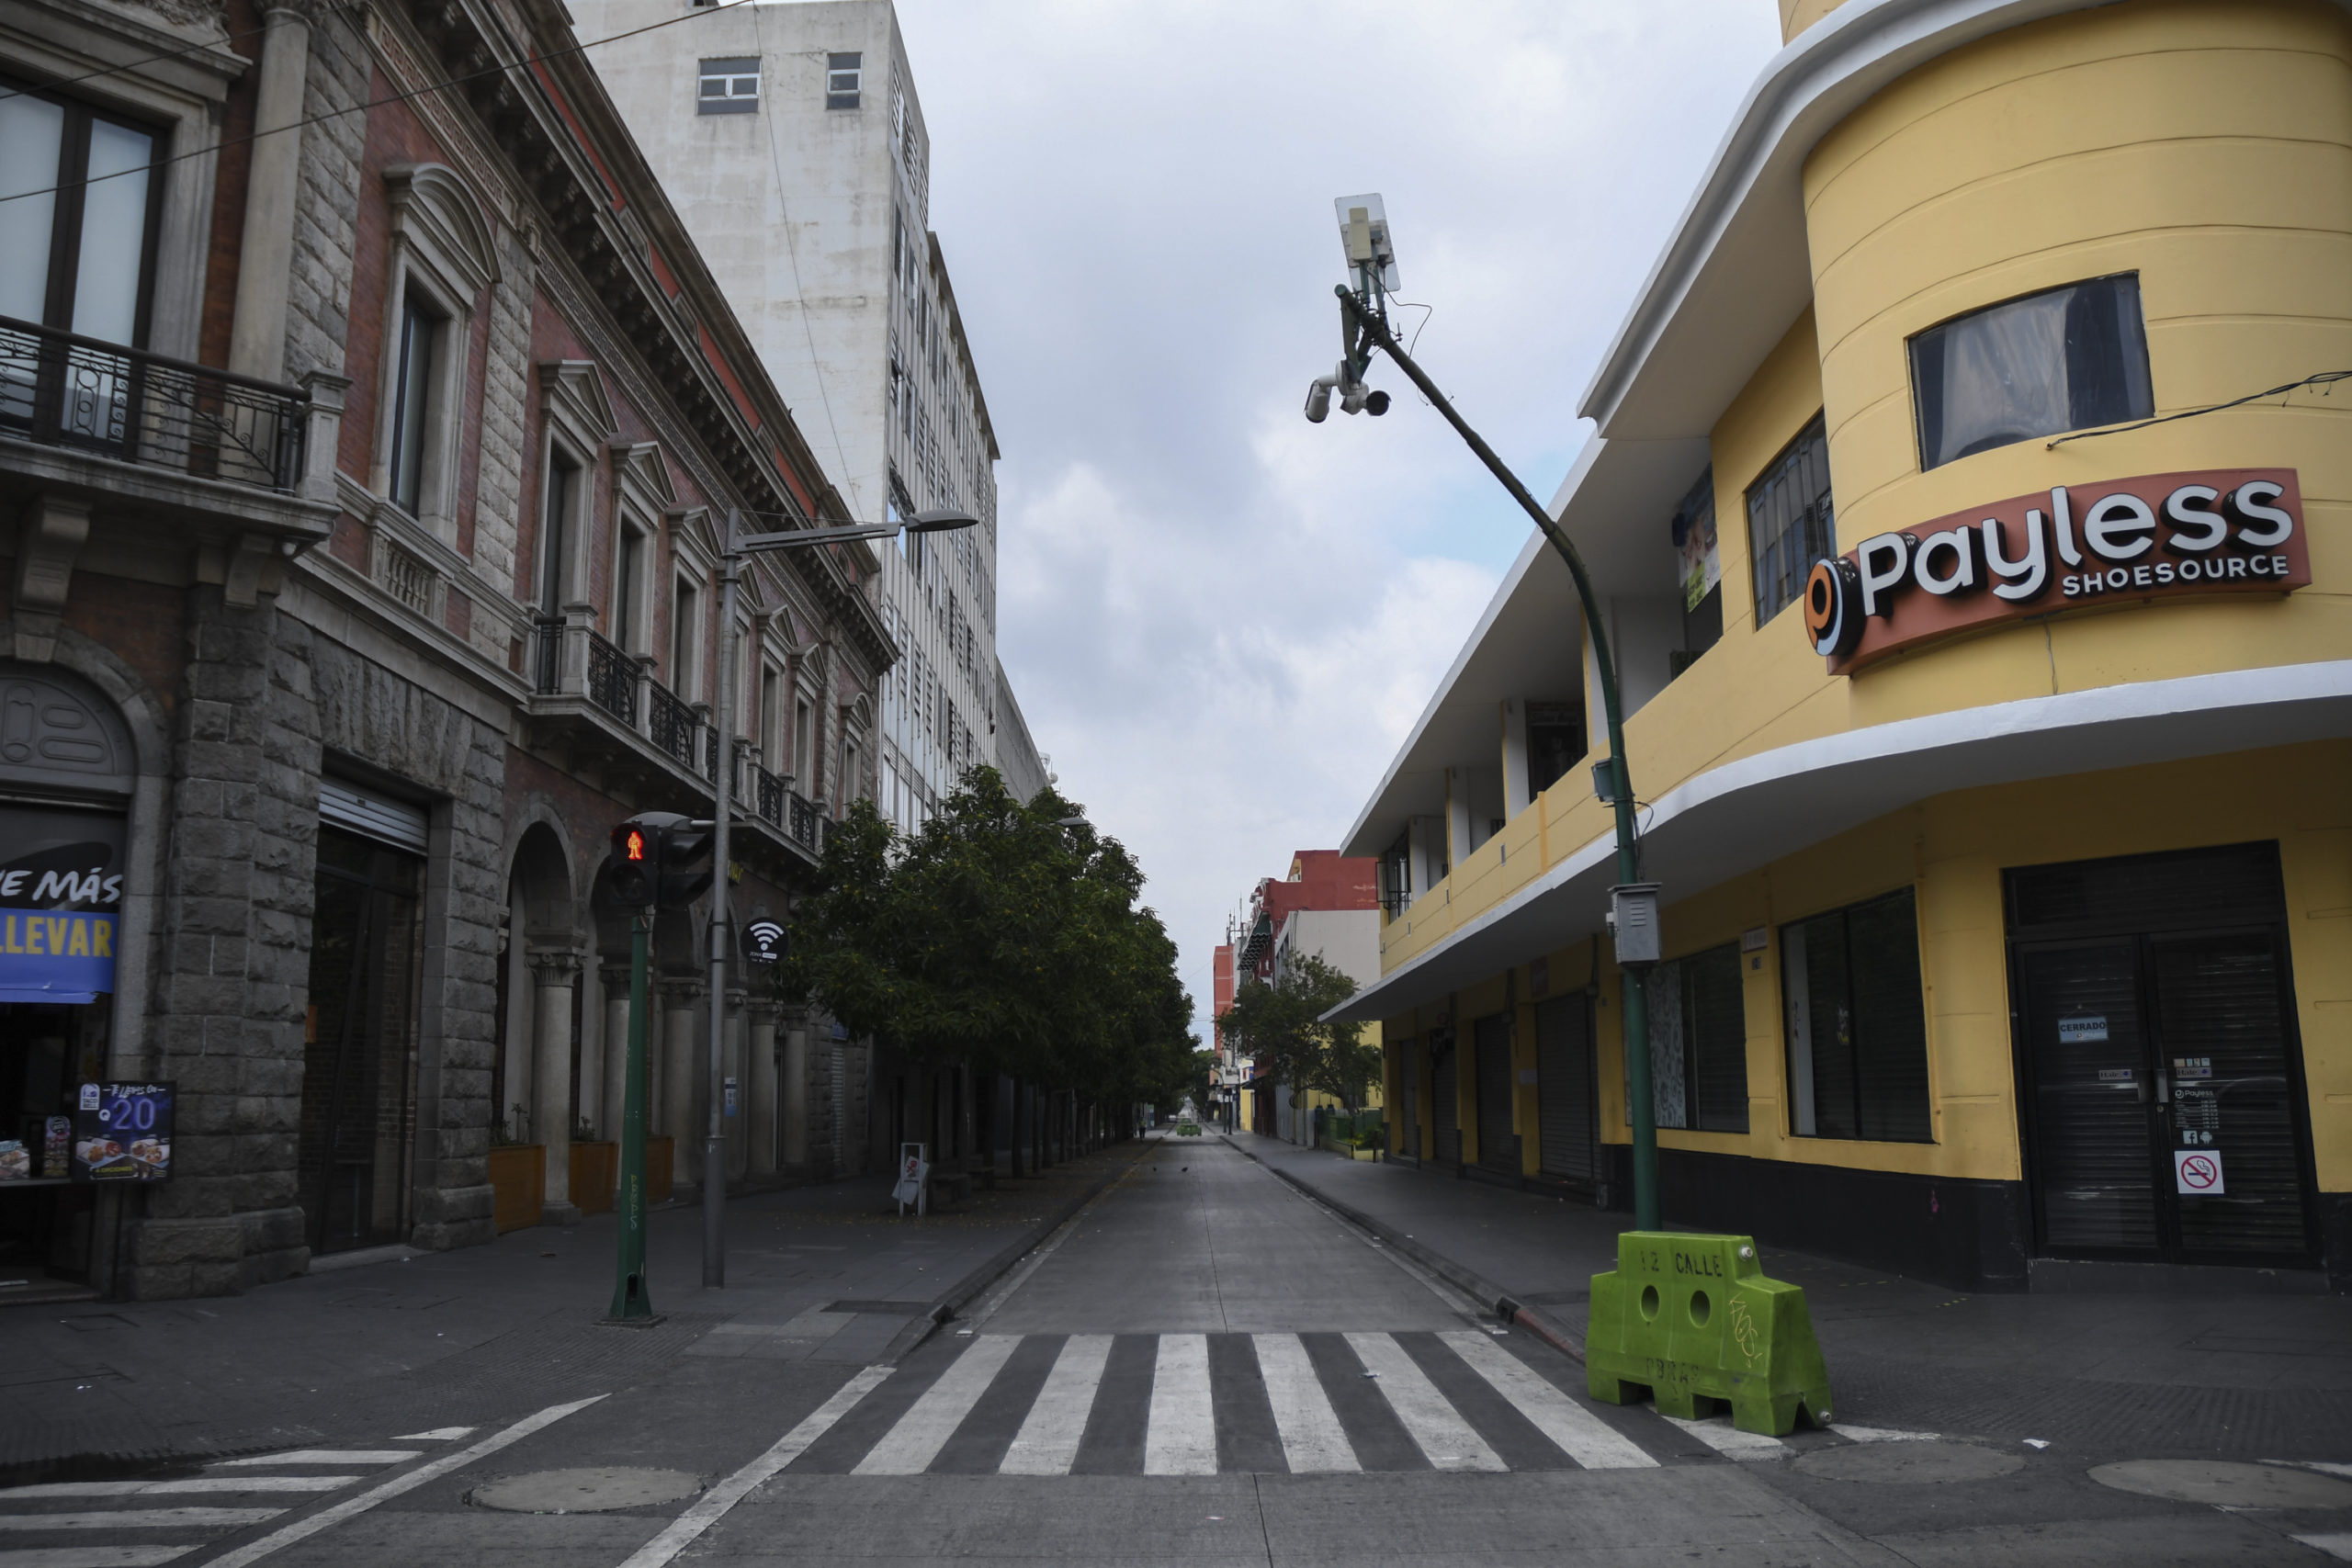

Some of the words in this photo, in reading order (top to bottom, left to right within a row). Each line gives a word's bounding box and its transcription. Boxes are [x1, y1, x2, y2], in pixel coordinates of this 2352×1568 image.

[1857, 479, 2294, 616] Payless
[2062, 554, 2290, 597] SHOESOURCE
[0, 869, 33, 897] E
[32, 867, 123, 904] MÁS
[0, 915, 112, 957] LEVAR
[2060, 1021, 2107, 1032] CERRADO
[2184, 1089, 2214, 1098] Payless
[112, 1099, 156, 1130] 20
[1676, 1252, 1723, 1278] CALLE
